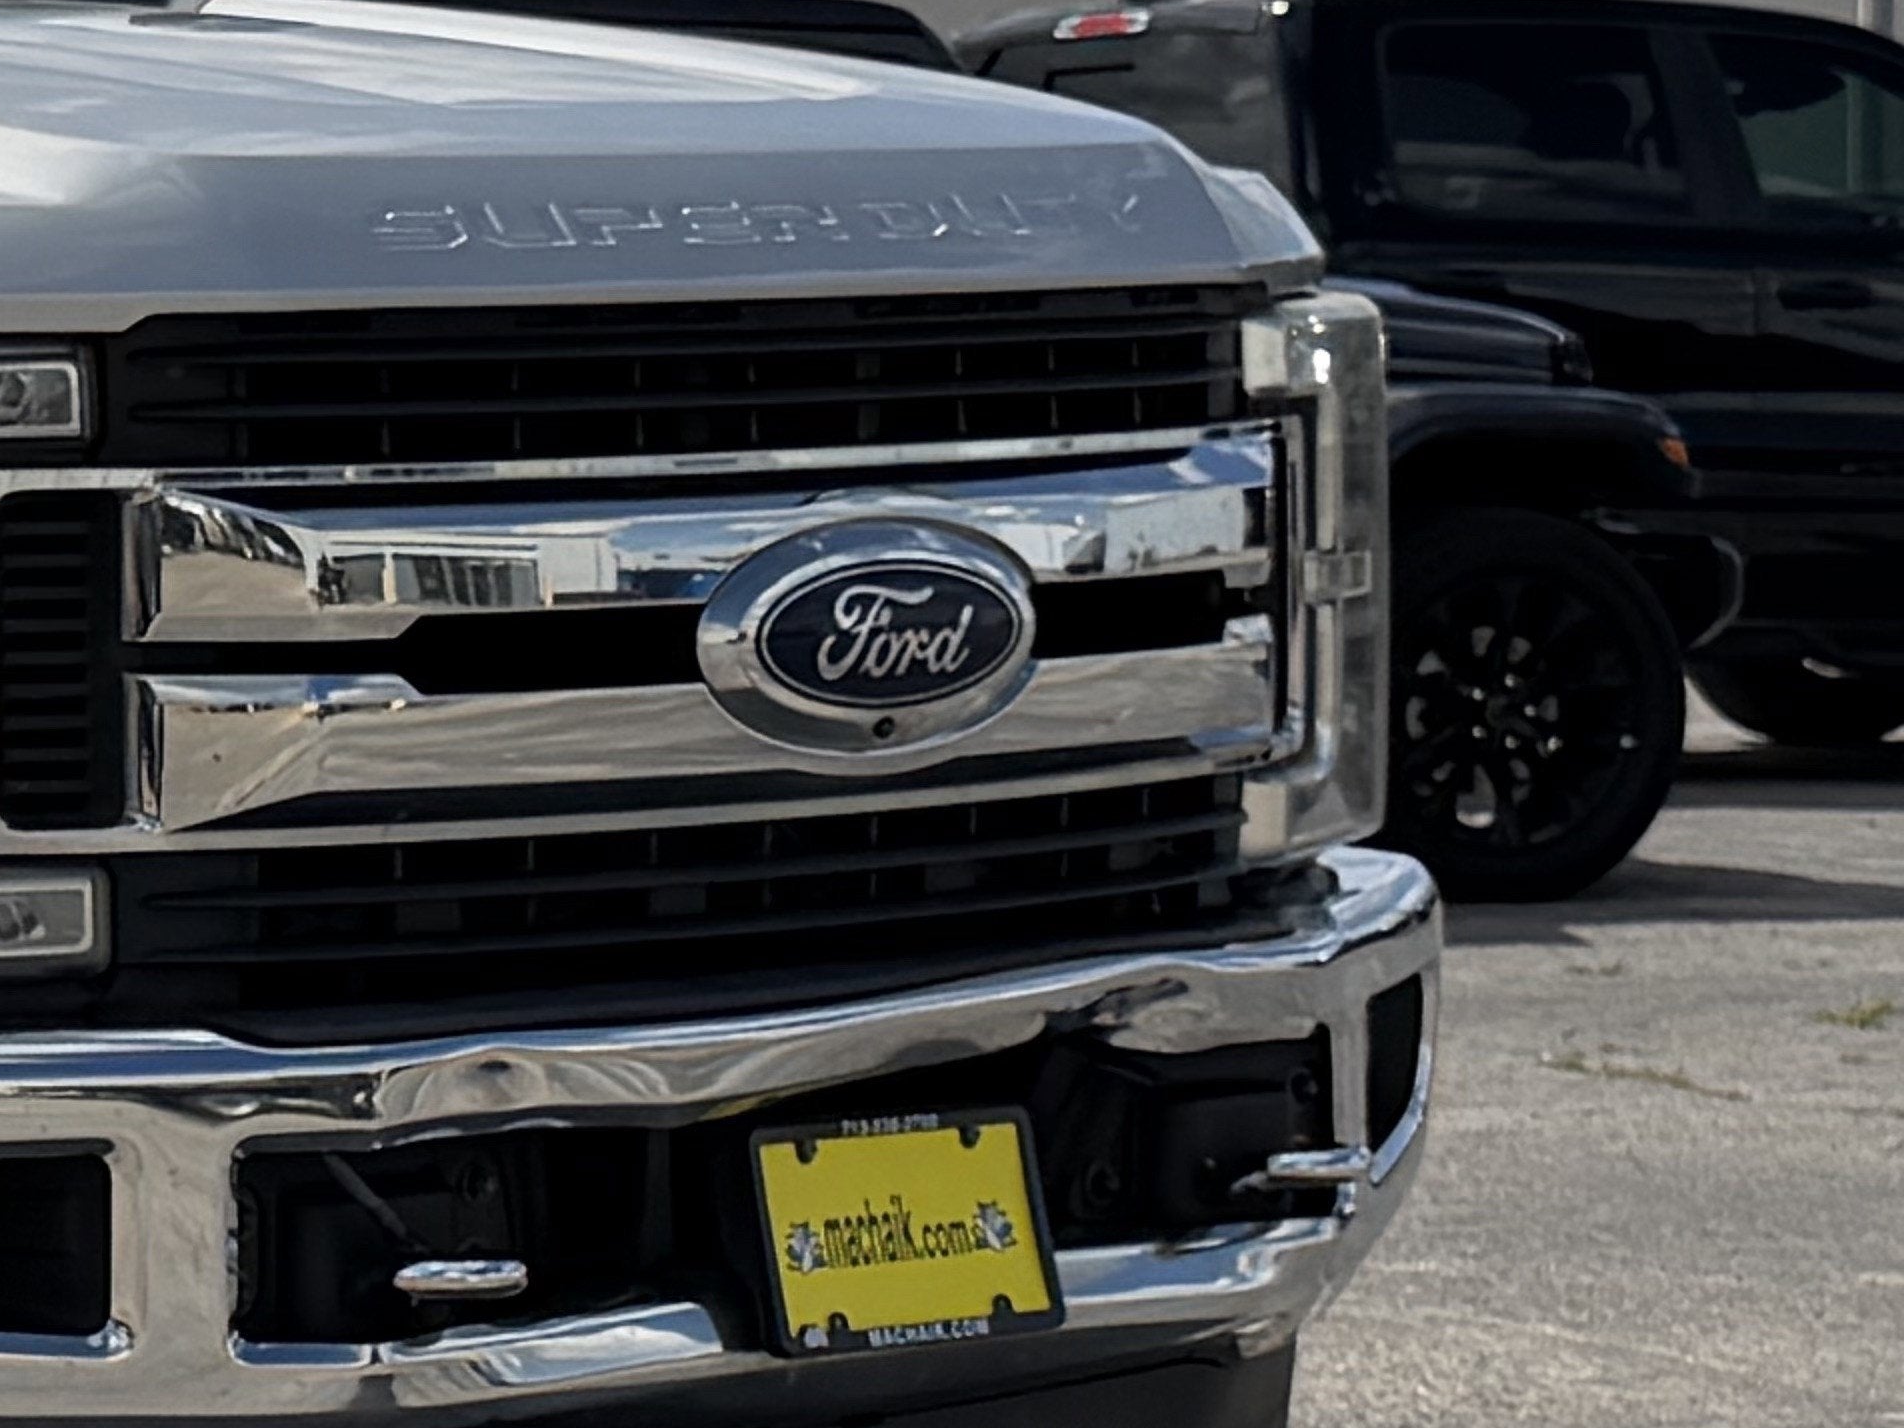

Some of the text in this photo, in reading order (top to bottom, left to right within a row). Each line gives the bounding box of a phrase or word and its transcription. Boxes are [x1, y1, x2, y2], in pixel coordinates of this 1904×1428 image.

[372, 200, 850, 250] SUPER
[816, 583, 975, 681] Ford
[822, 1194, 971, 1268] machaik.com
